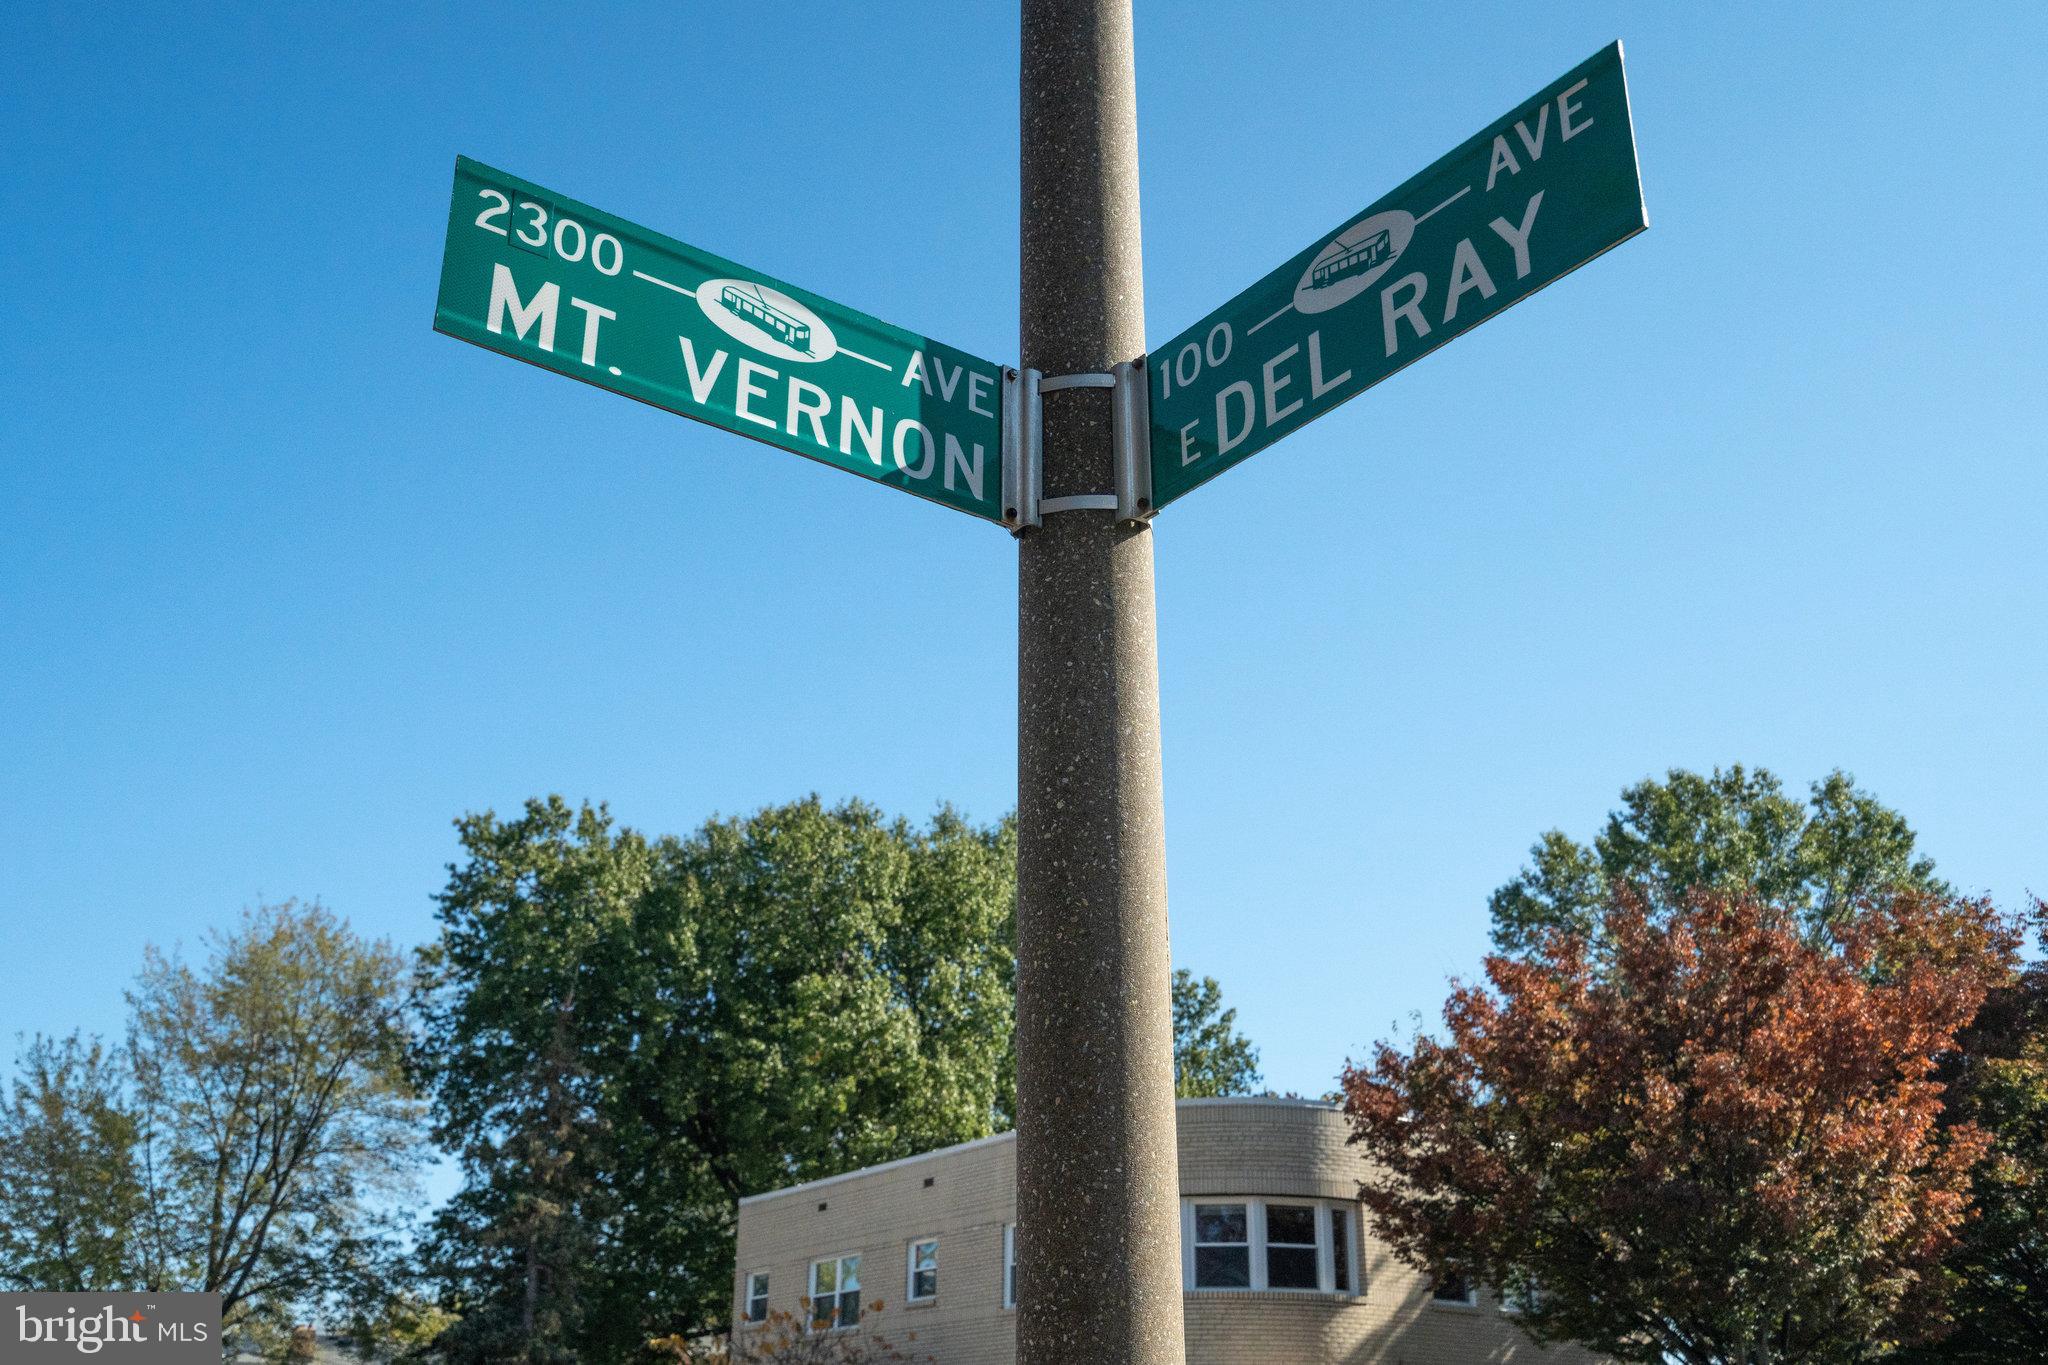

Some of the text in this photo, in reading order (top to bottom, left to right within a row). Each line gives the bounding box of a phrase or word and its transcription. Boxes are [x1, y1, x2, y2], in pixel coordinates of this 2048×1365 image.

[474, 189, 995, 419] 2300 AVE
[1159, 77, 1595, 400] 100 AVE
[1180, 189, 1546, 468] E DEL RAY
[485, 263, 985, 501] MT. VERNON
